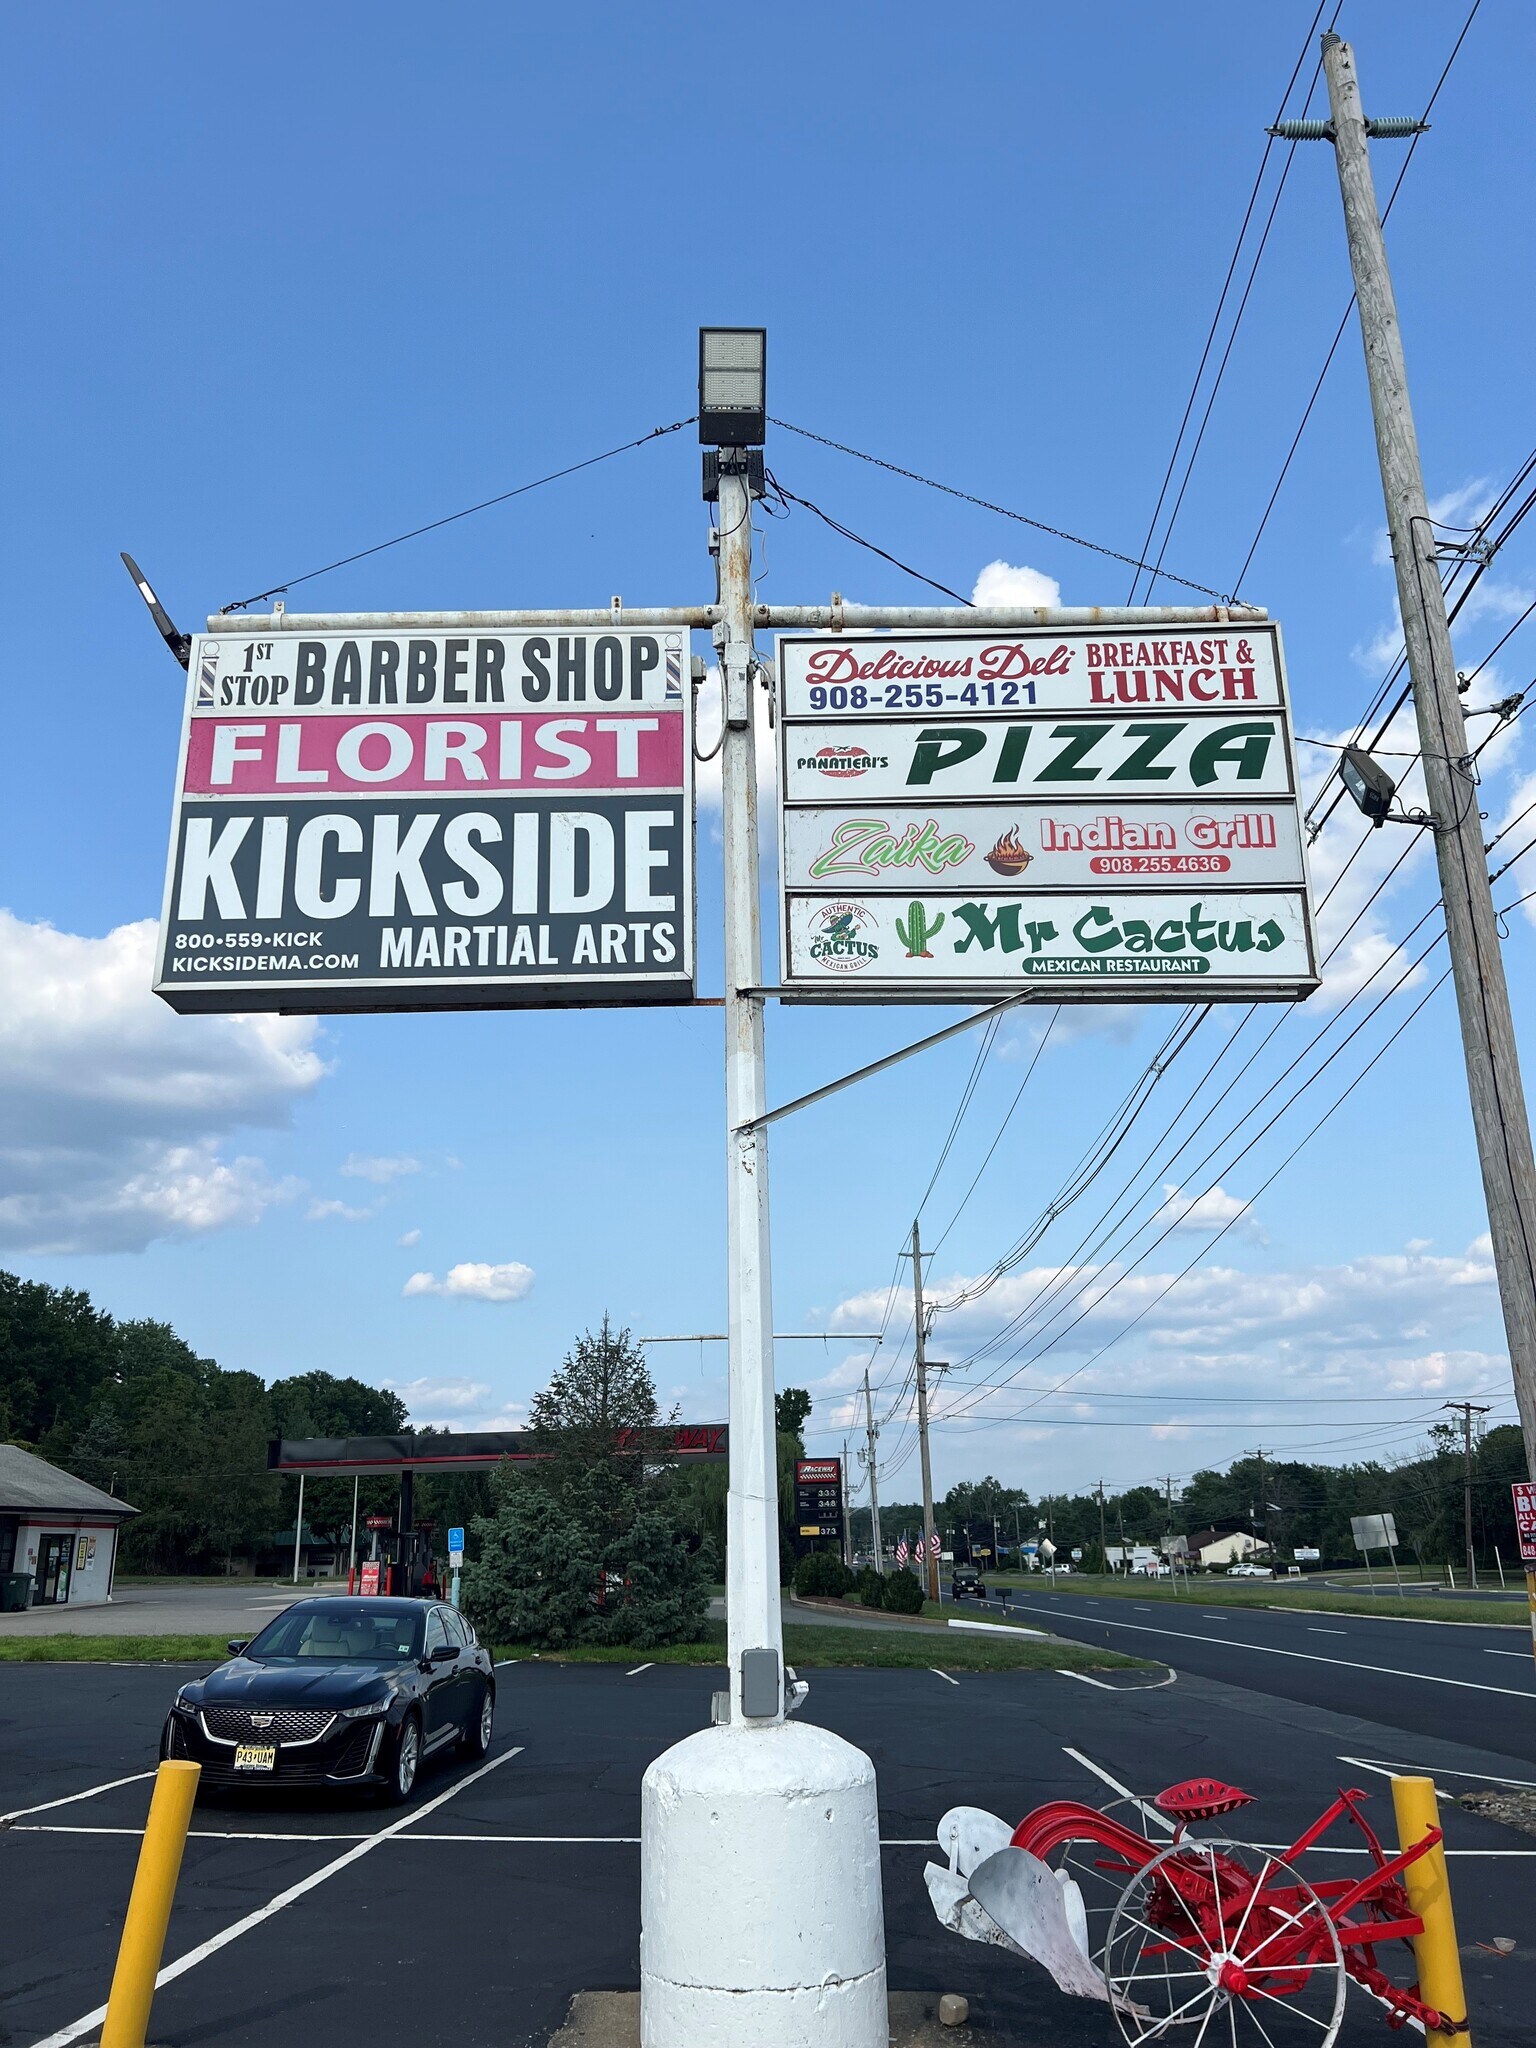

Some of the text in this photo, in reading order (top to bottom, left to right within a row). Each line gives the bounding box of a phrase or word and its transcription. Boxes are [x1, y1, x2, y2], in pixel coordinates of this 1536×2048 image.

[806, 644, 1075, 684] Delicious Deli
[1086, 639, 1254, 667] BREAKFAST &
[294, 635, 660, 705] BARBER SHOP
[1089, 667, 1257, 703] LUNCH
[220, 676, 289, 706] STOP
[809, 681, 1036, 710] 908-255-4121
[210, 718, 660, 785] FLORIST
[797, 756, 889, 771] PANATIERI'S
[905, 722, 1275, 787] PIZZA
[1040, 813, 1276, 851] Indian Grill
[809, 818, 976, 879] Zaika
[177, 811, 676, 920] KICKSIDE
[1100, 857, 1221, 873] 908.255.4636
[821, 905, 866, 918] AUTHENTIC
[952, 902, 1285, 954] Mr Cactus
[379, 921, 676, 968] MARTIAL ARTS
[810, 941, 879, 959] CACTUS
[172, 954, 359, 973] KICKSIDEMA.COM
[821, 957, 867, 970] MEXICAN GRILL
[1032, 958, 1201, 973] MEXICAN RESTAURANT
[1518, 1513, 1535, 1521] ALL
